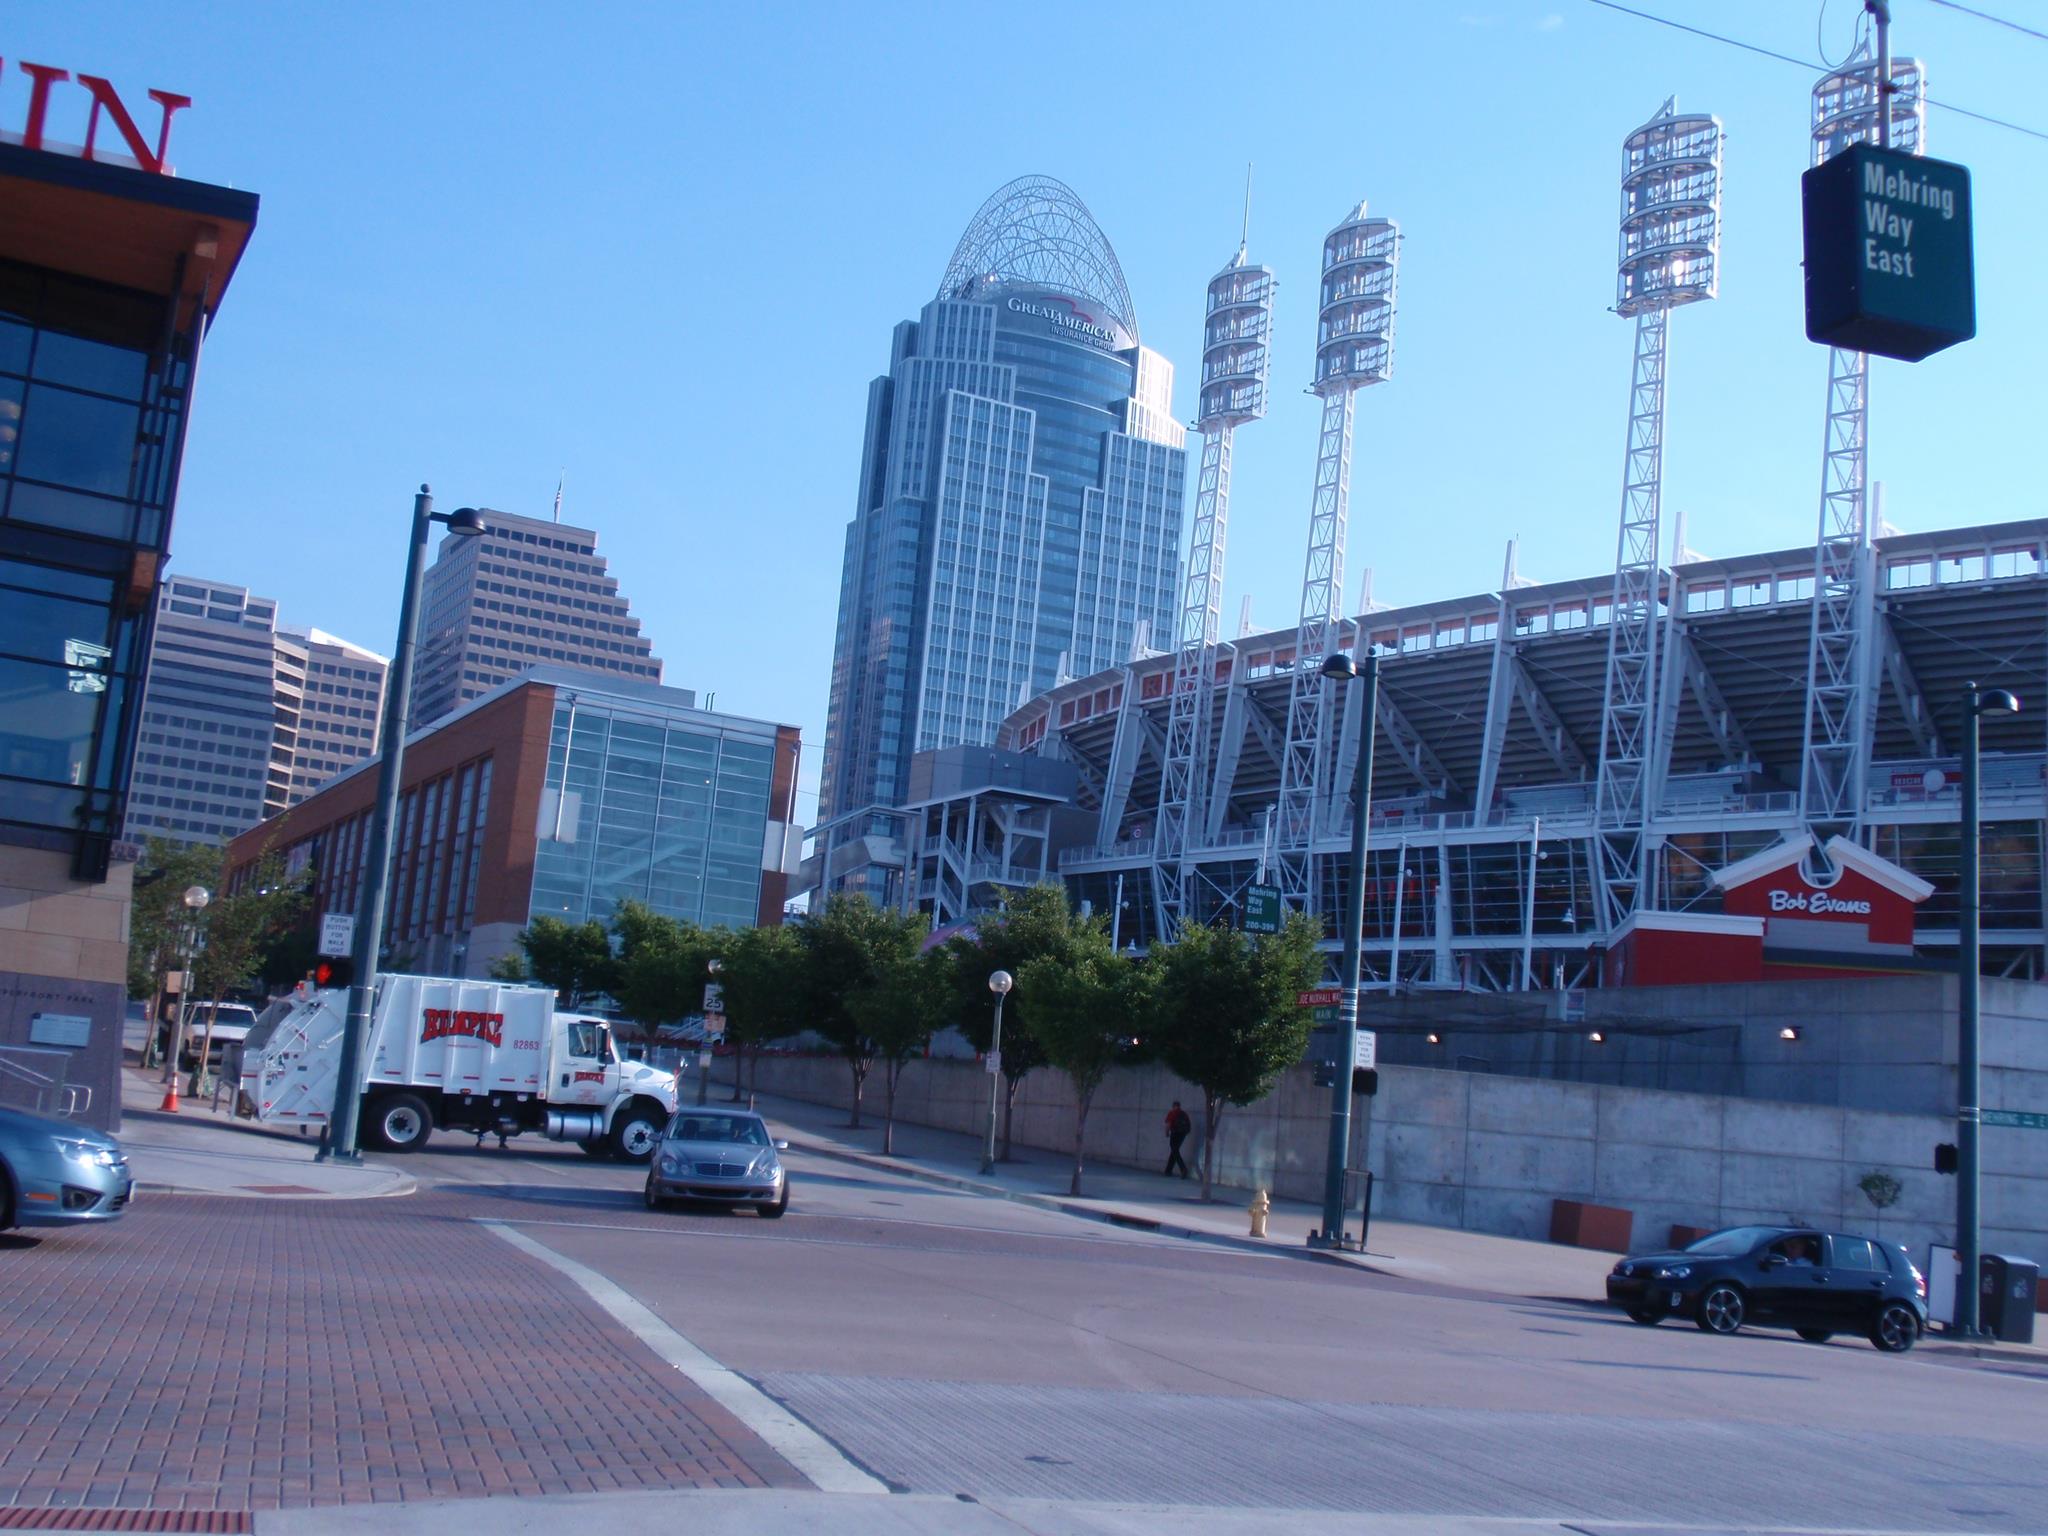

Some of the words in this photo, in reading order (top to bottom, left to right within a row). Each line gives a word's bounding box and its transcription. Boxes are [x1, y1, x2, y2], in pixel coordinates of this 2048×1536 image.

[0, 56, 191, 174] IN
[1864, 161, 1954, 219] Mehring
[1865, 200, 1913, 247] Way
[1865, 238, 1914, 278] East
[1249, 886, 1277, 899] Mehring
[1249, 896, 1263, 907] Way
[1768, 890, 1807, 911] Bob
[1808, 892, 1871, 914] Evans
[1247, 905, 1263, 914] East
[706, 998, 720, 1009] 25
